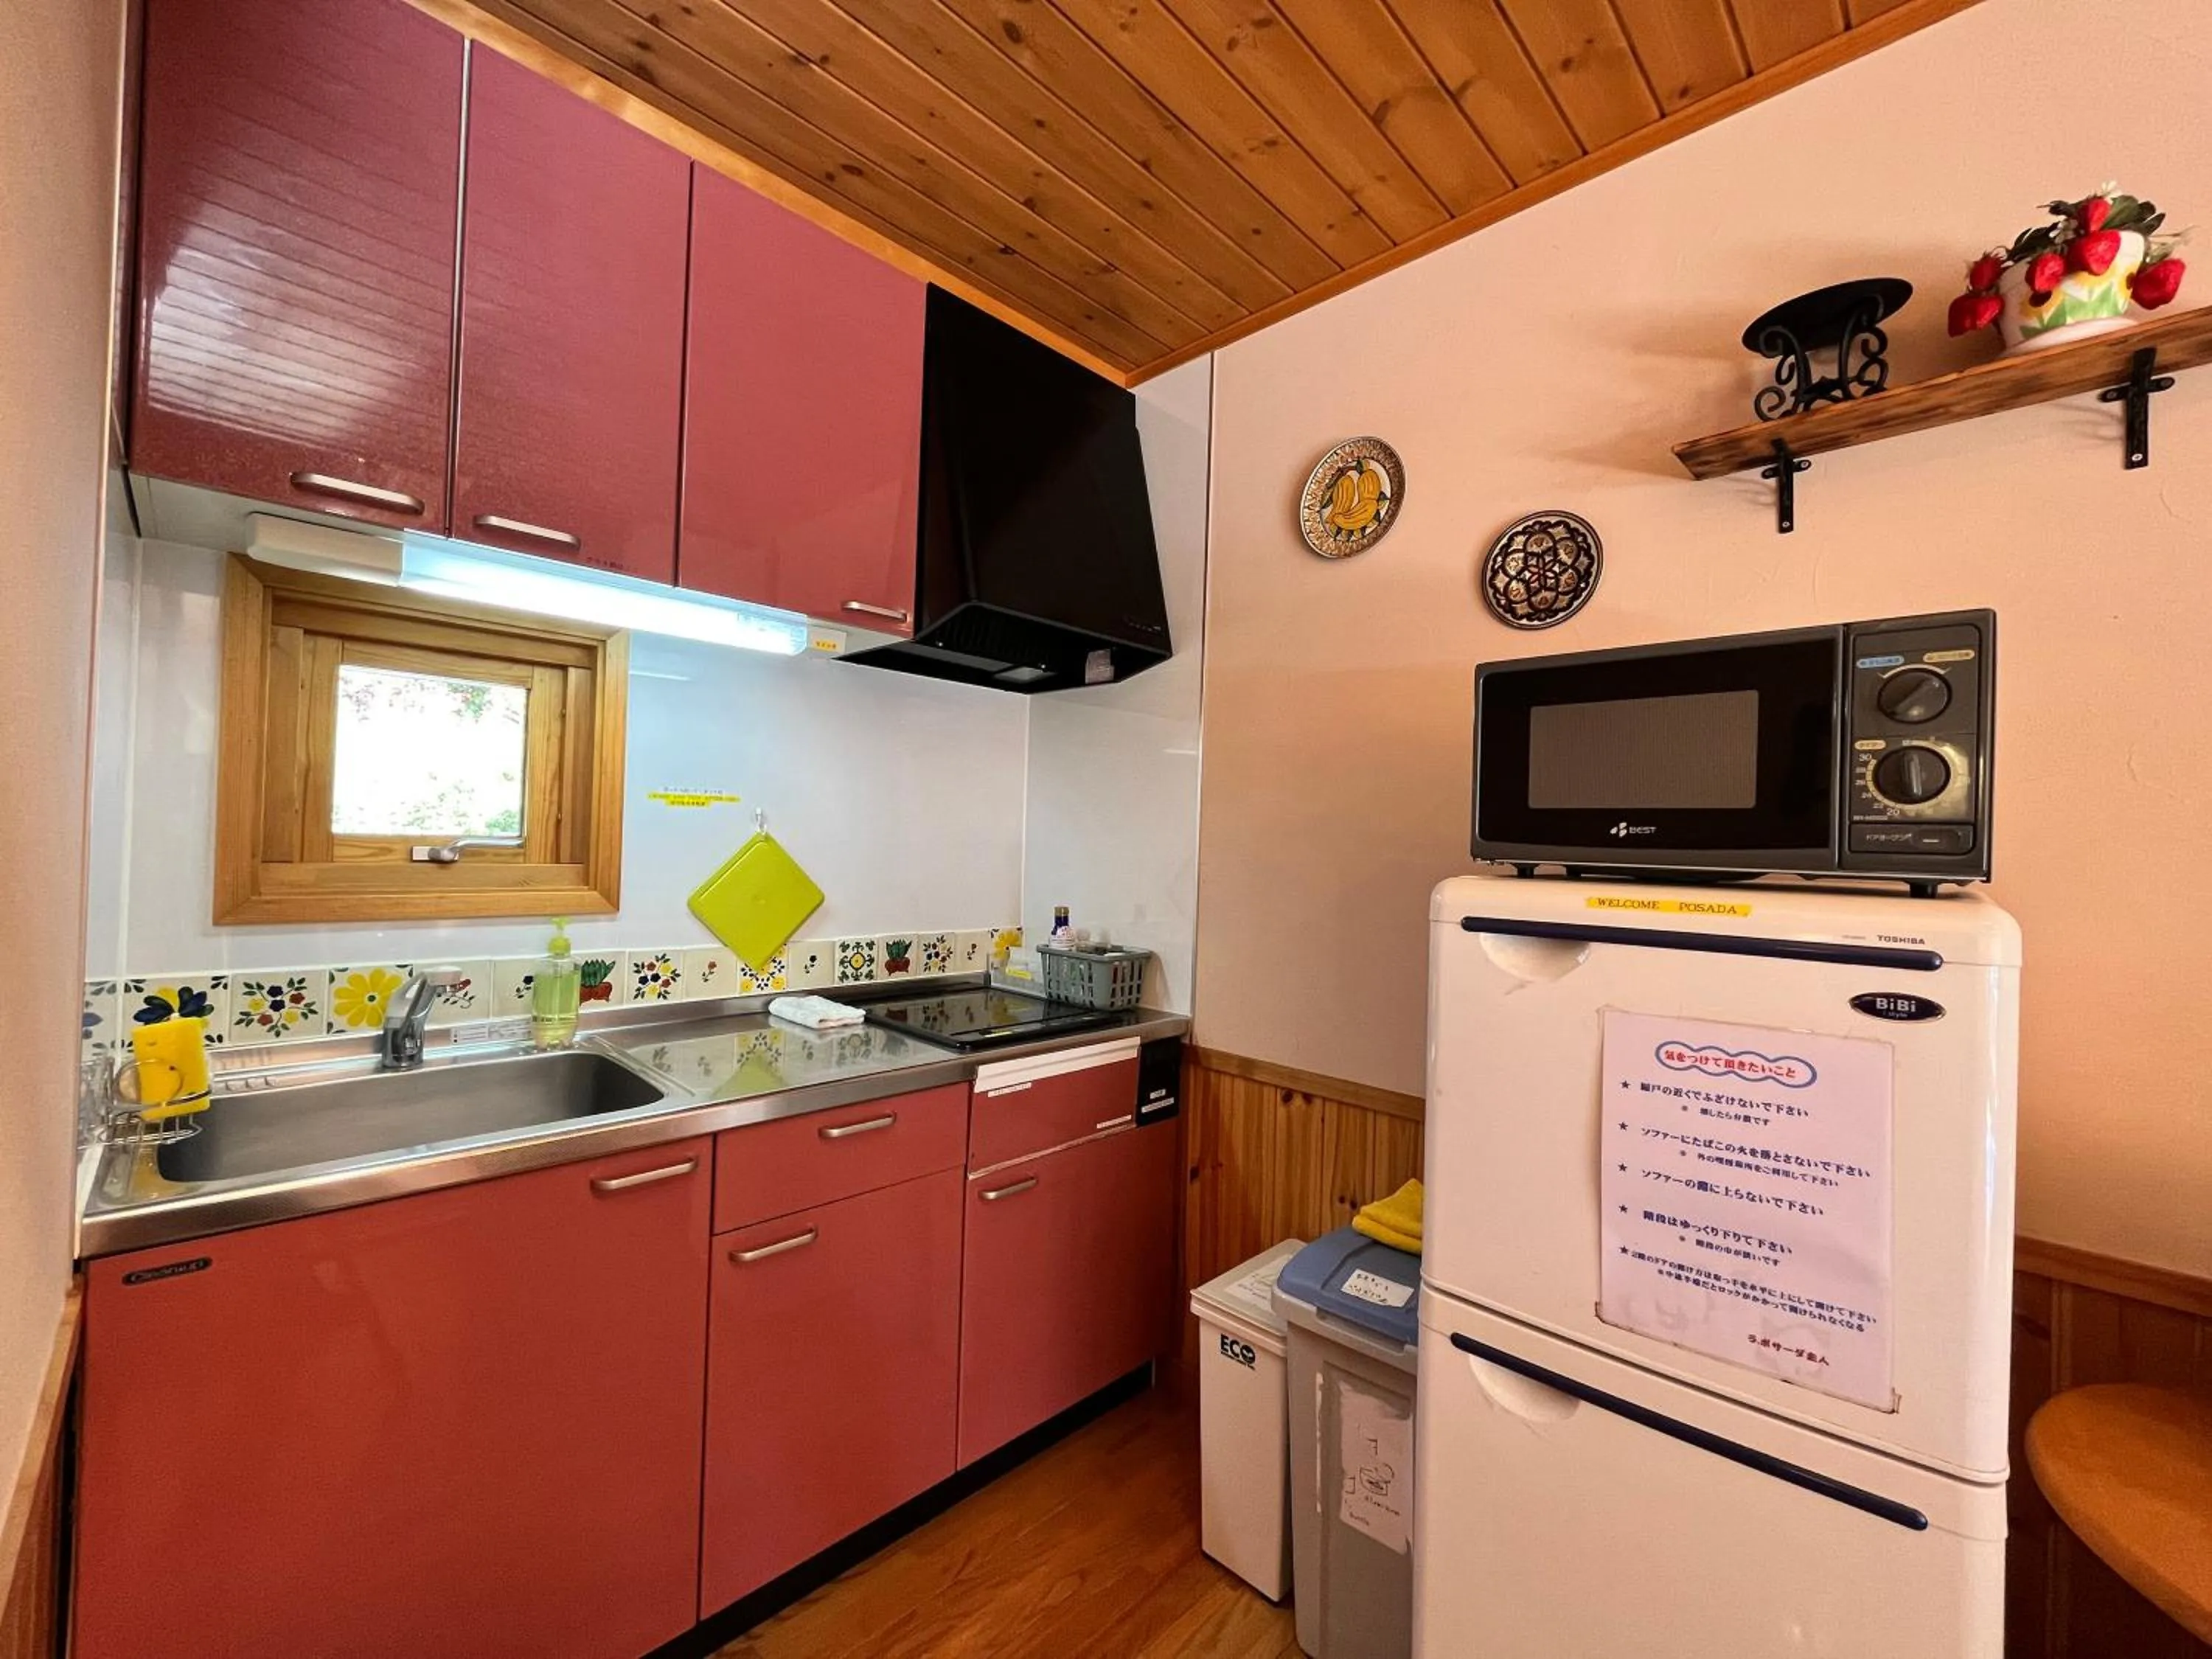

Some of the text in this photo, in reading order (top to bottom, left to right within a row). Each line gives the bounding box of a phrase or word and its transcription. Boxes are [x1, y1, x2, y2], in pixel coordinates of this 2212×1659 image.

[1886, 808, 1900, 816] 20
[1629, 827, 1658, 835] BEST
[1597, 897, 1737, 915] WELCOME POSADA
[1877, 934, 1926, 945] TOSHIBA
[1875, 998, 1916, 1012] BiBi
[1664, 1049, 1797, 1079] 気をつけて頂きたいこと
[1220, 1333, 1256, 1365] ECO
